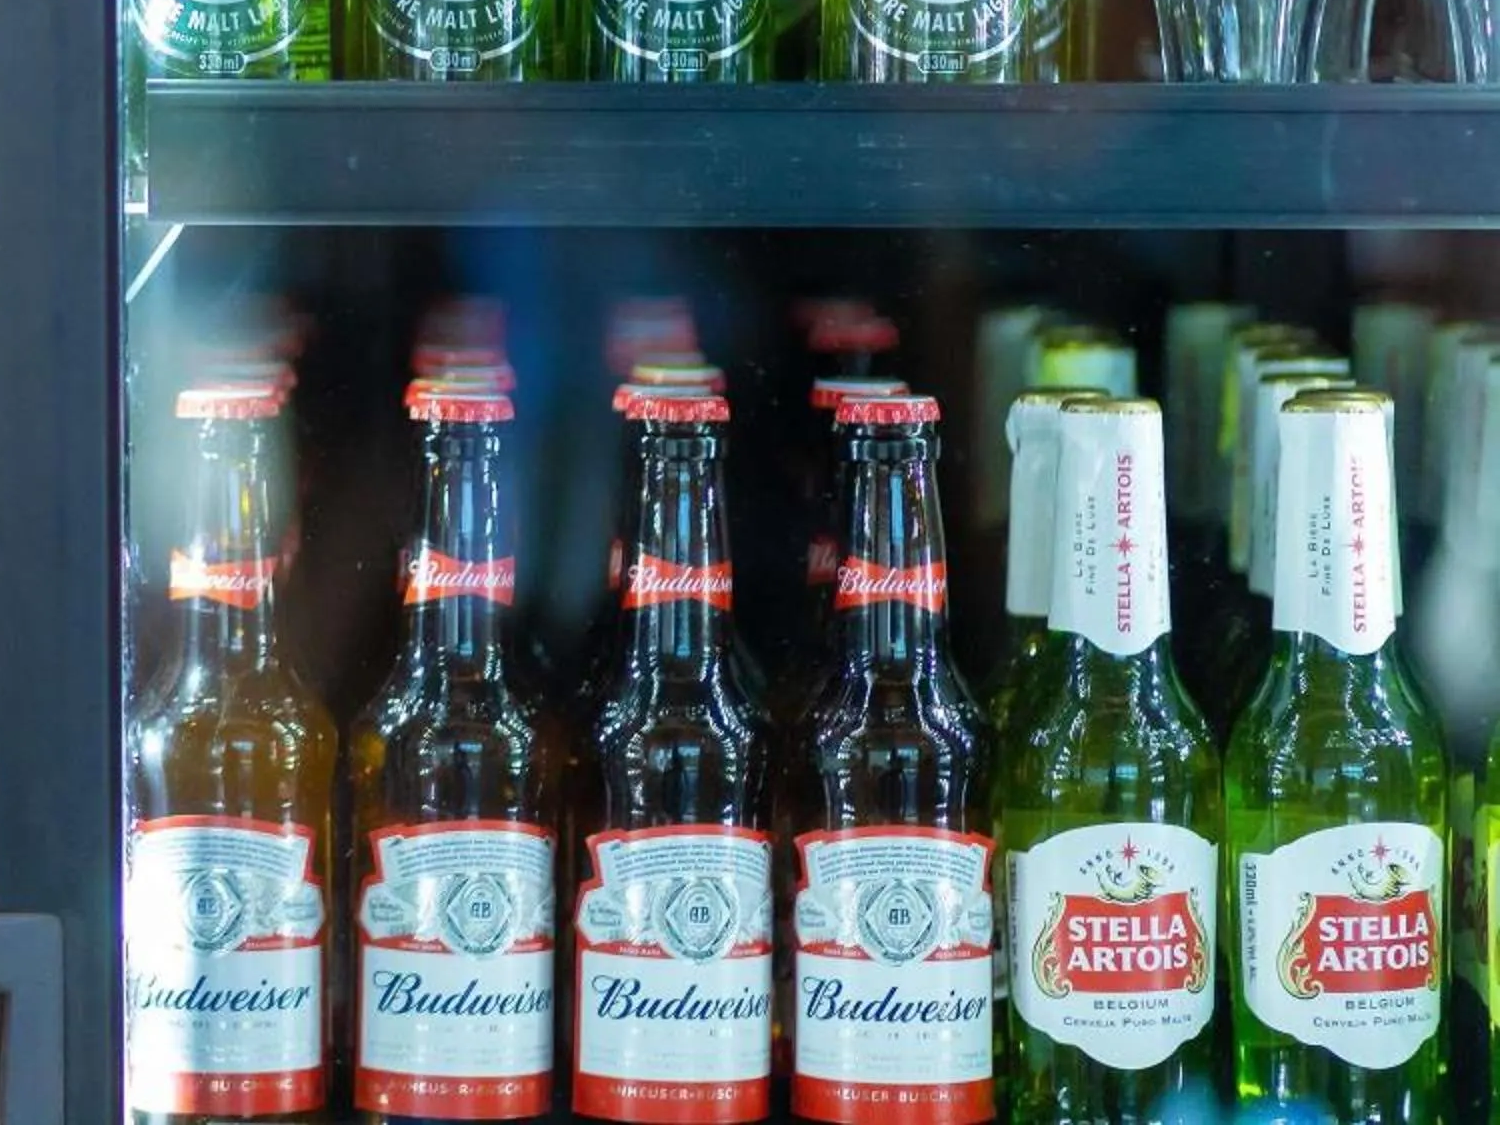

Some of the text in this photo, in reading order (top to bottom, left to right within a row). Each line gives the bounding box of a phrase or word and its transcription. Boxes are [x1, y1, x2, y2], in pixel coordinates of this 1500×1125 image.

[188, 10, 239, 33] MALT
[426, 8, 477, 29] MALT
[653, 9, 705, 30] MALT
[913, 11, 965, 32] MALT
[199, 54, 239, 70] 330ml
[923, 55, 964, 70] 330ml
[1117, 454, 1133, 633] STELLA ARTOIS
[408, 559, 514, 588] Budweis
[628, 564, 732, 594] Budweise
[838, 565, 945, 594] Budweiser
[1353, 562, 1366, 633] STELLA
[1068, 914, 1187, 942] STELLA
[1319, 912, 1429, 942] STELLA
[1067, 944, 1187, 972] ARTOIS
[1318, 941, 1429, 972] ARTOIS
[802, 976, 987, 1024] Budweiser
[1094, 999, 1169, 1010] BELGIUM
[1345, 996, 1415, 1010] BELGIUM
